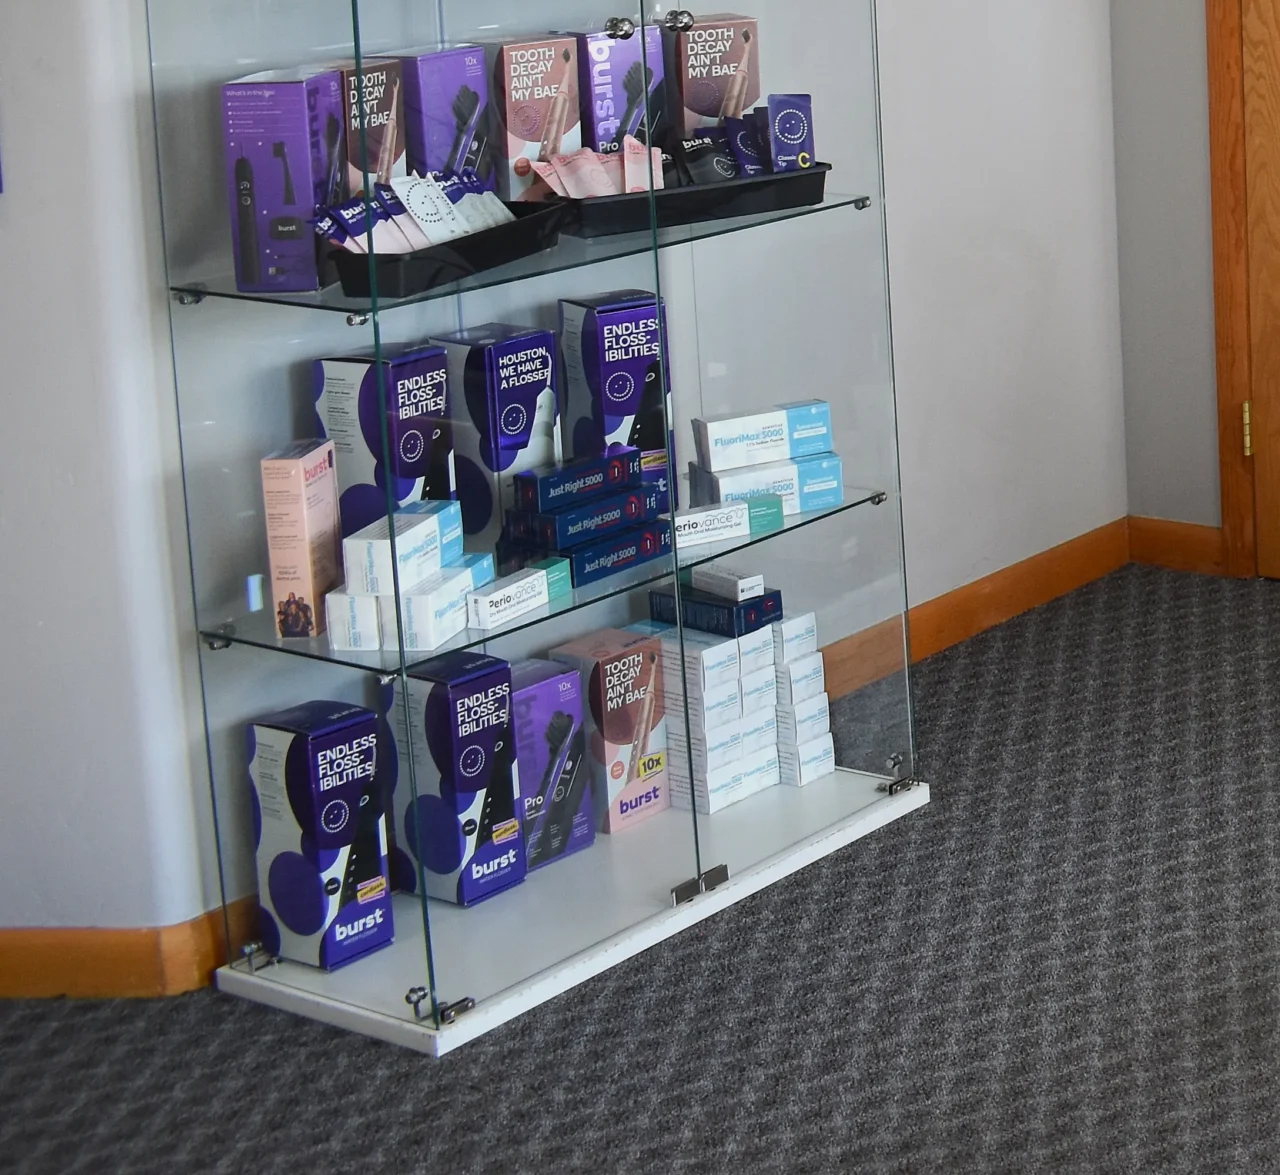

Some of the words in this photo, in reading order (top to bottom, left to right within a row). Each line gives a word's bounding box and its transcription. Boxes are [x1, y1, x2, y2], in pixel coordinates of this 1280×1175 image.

[686, 27, 734, 42] TOOTH
[510, 47, 555, 63] TOOTH
[688, 40, 732, 54] DECAY
[465, 56, 477, 65] 10x
[510, 60, 553, 76] DECAY
[688, 53, 722, 67] AIN'T
[349, 71, 386, 89] TOTH
[688, 66, 709, 79] MY
[712, 63, 738, 76] BAE
[511, 74, 544, 89] AIN'T
[588, 37, 621, 134] burst
[512, 89, 534, 102] MY
[534, 84, 559, 99] BAE
[371, 111, 389, 126] BAE
[599, 141, 618, 153] Pro
[798, 152, 810, 168] C
[604, 333, 651, 350] FLOSS-
[499, 347, 549, 367] HOUSTON,
[605, 342, 660, 362] IBILITIES
[500, 365, 516, 378] WE
[517, 359, 543, 373] HAVE
[397, 369, 446, 394] ENDLESS
[501, 379, 508, 390] A
[399, 387, 437, 407] FLOSS-
[714, 432, 760, 447] FluoriMax
[762, 429, 783, 439] 5000
[304, 457, 328, 482] burst
[548, 484, 564, 498] Just
[565, 479, 584, 494] Right
[585, 473, 603, 486] 5000
[725, 488, 771, 502] FluoriMax
[772, 483, 794, 493] 5000
[567, 522, 582, 535] Just
[583, 516, 602, 530] Right
[603, 509, 621, 522] 5000
[676, 514, 733, 533] eriovance
[584, 560, 599, 573] Just
[600, 554, 618, 568] Right
[618, 546, 636, 559] 5000
[489, 583, 536, 609] Periovance
[604, 652, 643, 676] TOOTH
[606, 665, 641, 688] DECAY
[559, 682, 571, 692] 10x
[606, 679, 634, 700] AIN'T
[456, 683, 510, 712] ENDLESS
[607, 698, 623, 712] MY
[626, 686, 647, 704] BAE
[458, 701, 498, 725] FLOSS-
[318, 733, 377, 765] ENDLESS
[319, 753, 364, 778] FLOSS-
[642, 756, 662, 773] 10x
[524, 795, 544, 809] Pro
[619, 786, 660, 815] burst
[472, 848, 517, 879] burst
[335, 908, 384, 941] burst
